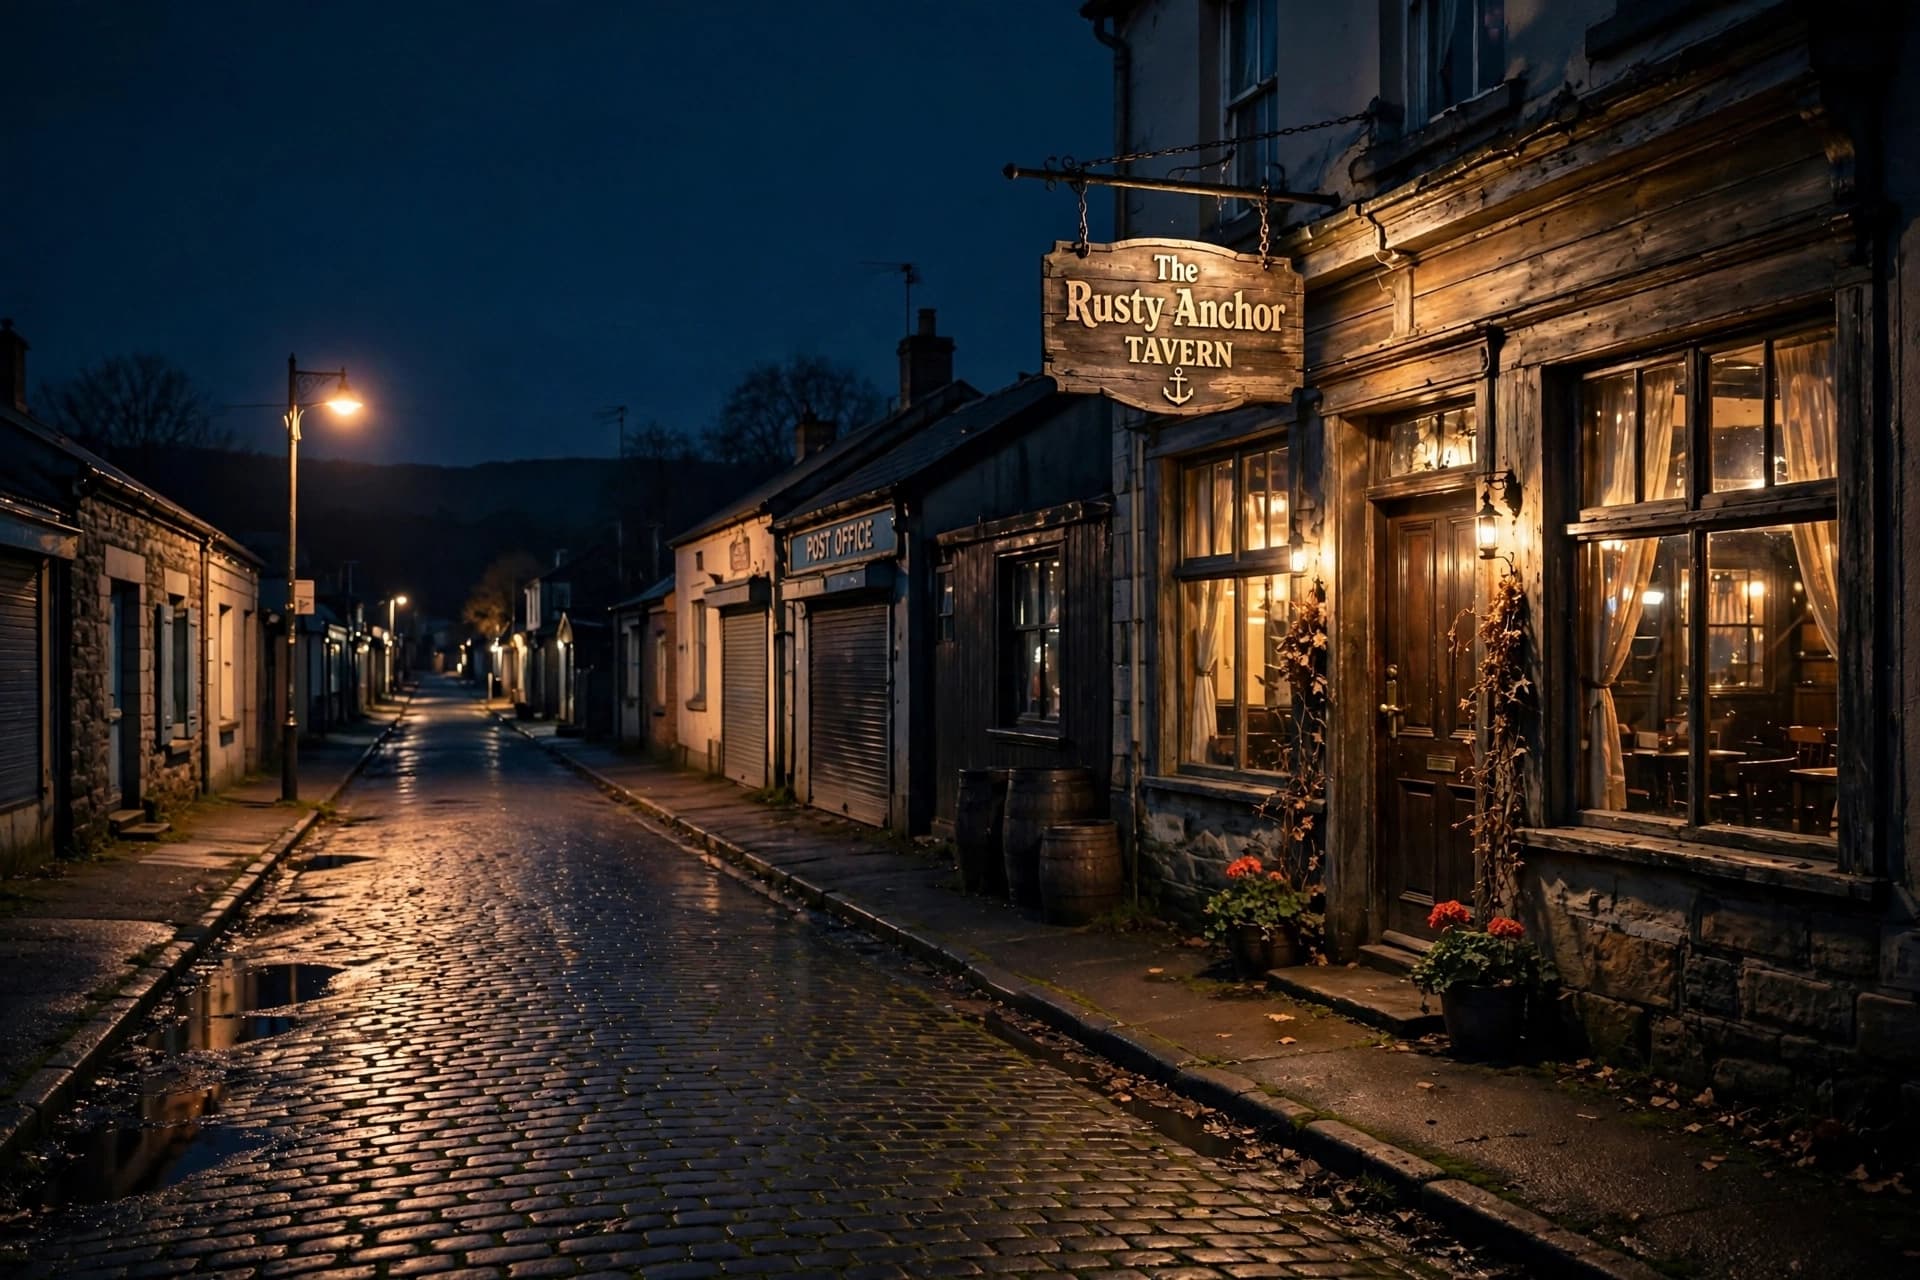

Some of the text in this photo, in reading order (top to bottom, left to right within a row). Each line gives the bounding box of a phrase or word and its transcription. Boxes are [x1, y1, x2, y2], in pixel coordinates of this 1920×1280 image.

[1154, 254, 1198, 283] The
[1065, 280, 1286, 332] Rusty Anchor
[1125, 336, 1233, 368] TAVERN
[806, 519, 873, 561] POST OFFICE
